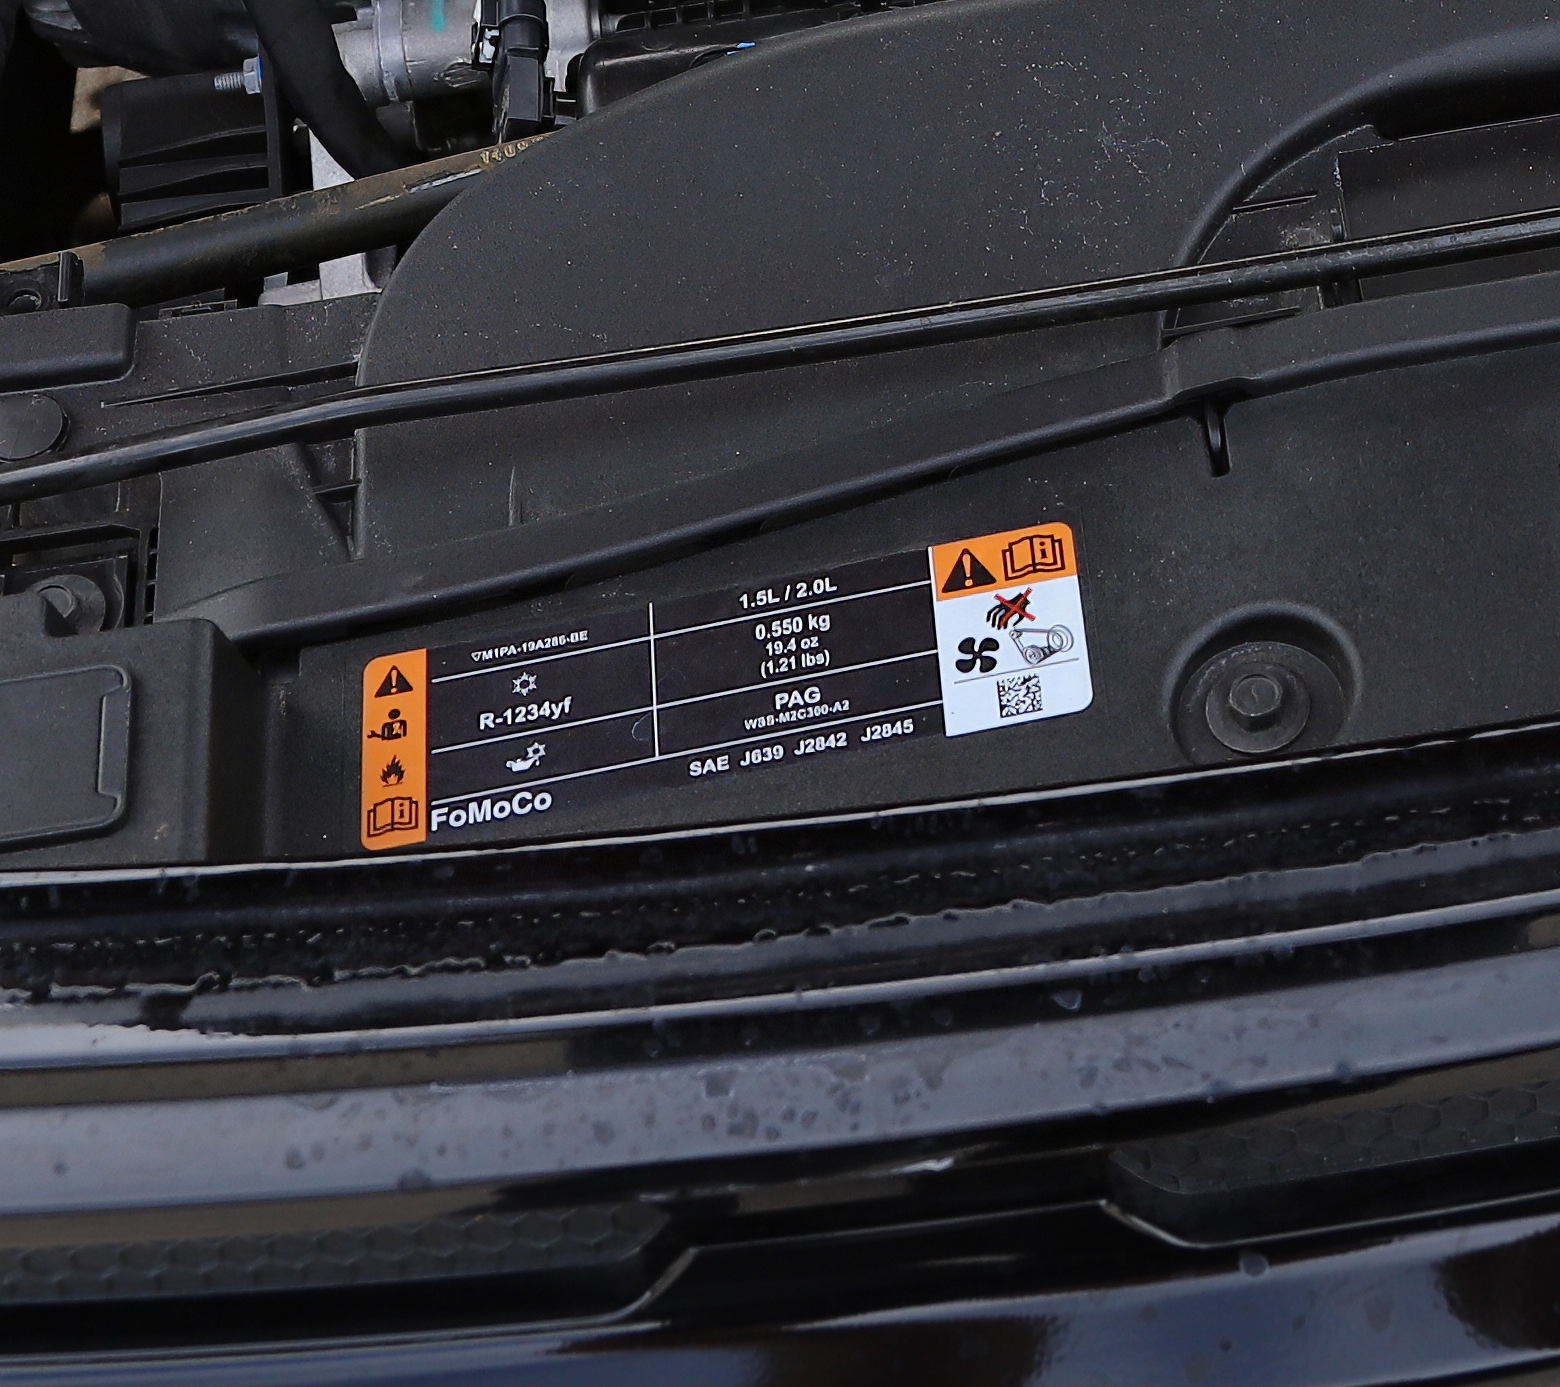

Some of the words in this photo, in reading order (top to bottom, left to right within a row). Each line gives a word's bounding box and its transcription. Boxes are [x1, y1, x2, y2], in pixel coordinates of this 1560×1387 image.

[739, 588, 781, 610] 1.5L
[784, 584, 791, 601] /
[795, 577, 838, 598] 2.0L
[755, 616, 803, 641] 0.550
[808, 613, 831, 632] kg
[765, 637, 797, 657] 19.4
[800, 636, 819, 649] oz
[760, 656, 797, 679] (1.21
[801, 649, 831, 669] lbs)
[479, 696, 573, 730] R-1234yf
[774, 687, 821, 711] PAG
[689, 755, 730, 777] SAE
[739, 745, 784, 767] J639
[793, 732, 848, 757] J2842
[860, 718, 914, 742] J2845
[431, 791, 553, 832] FoMoCo
